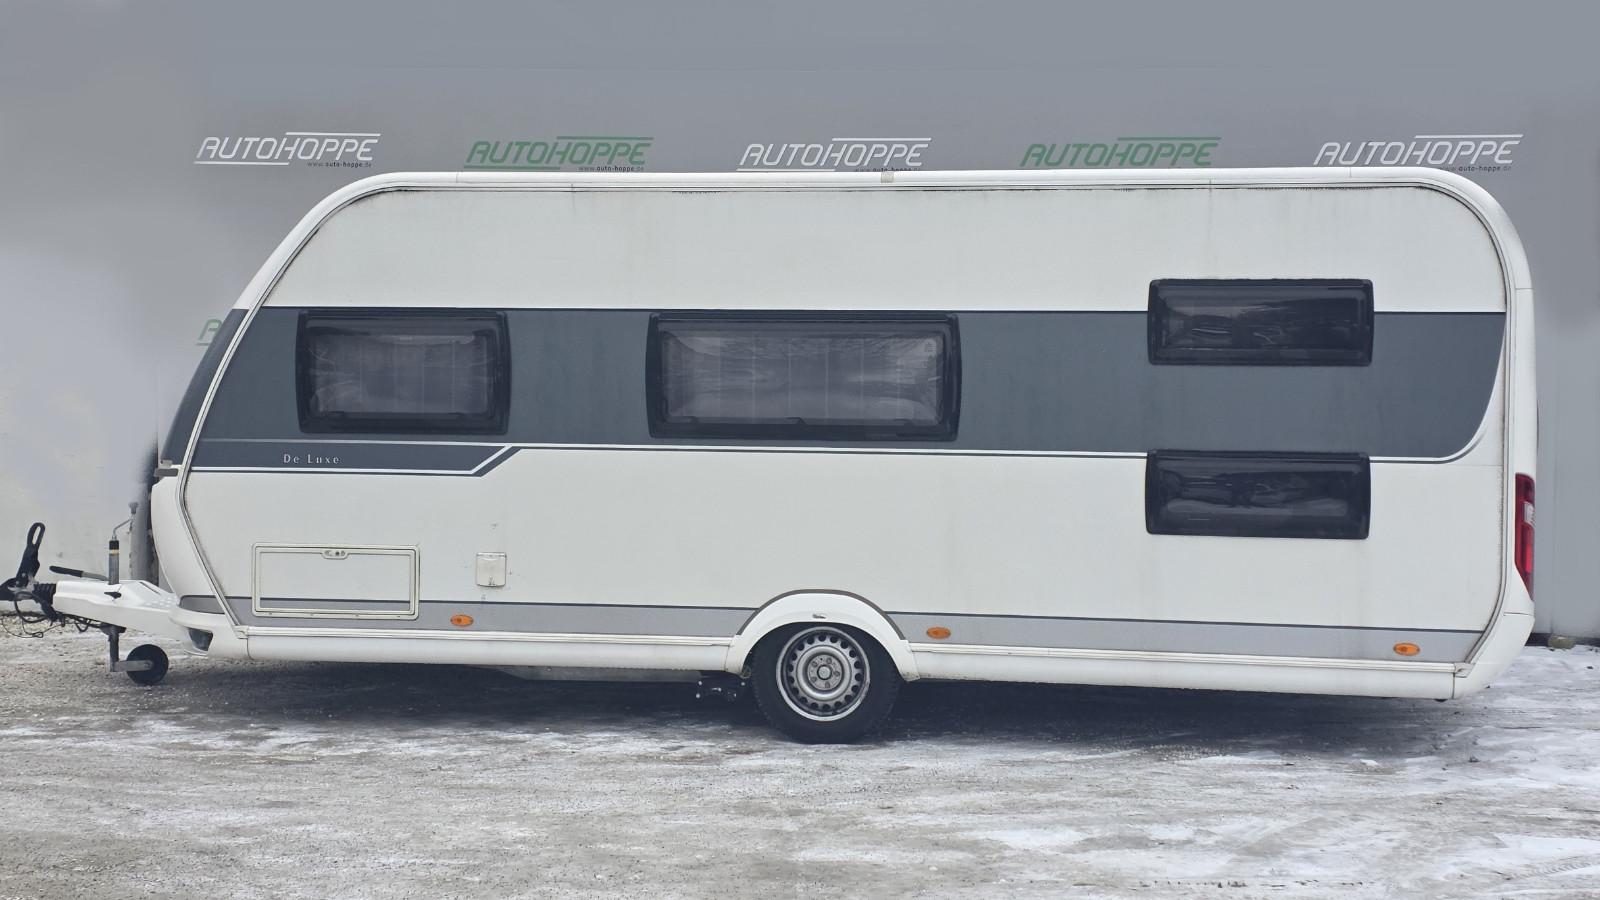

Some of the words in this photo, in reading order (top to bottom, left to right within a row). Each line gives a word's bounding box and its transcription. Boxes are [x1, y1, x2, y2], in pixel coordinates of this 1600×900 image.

[196, 136, 378, 161] AUTOHOPPE
[466, 140, 652, 166] AUTOHOPPE
[739, 143, 929, 167] AUTOHOPPE
[1019, 142, 1219, 167] AUTOHOPPE
[1313, 140, 1521, 165] AUTOHOPPE
[283, 453, 300, 464] De
[307, 453, 340, 464] Luxe
